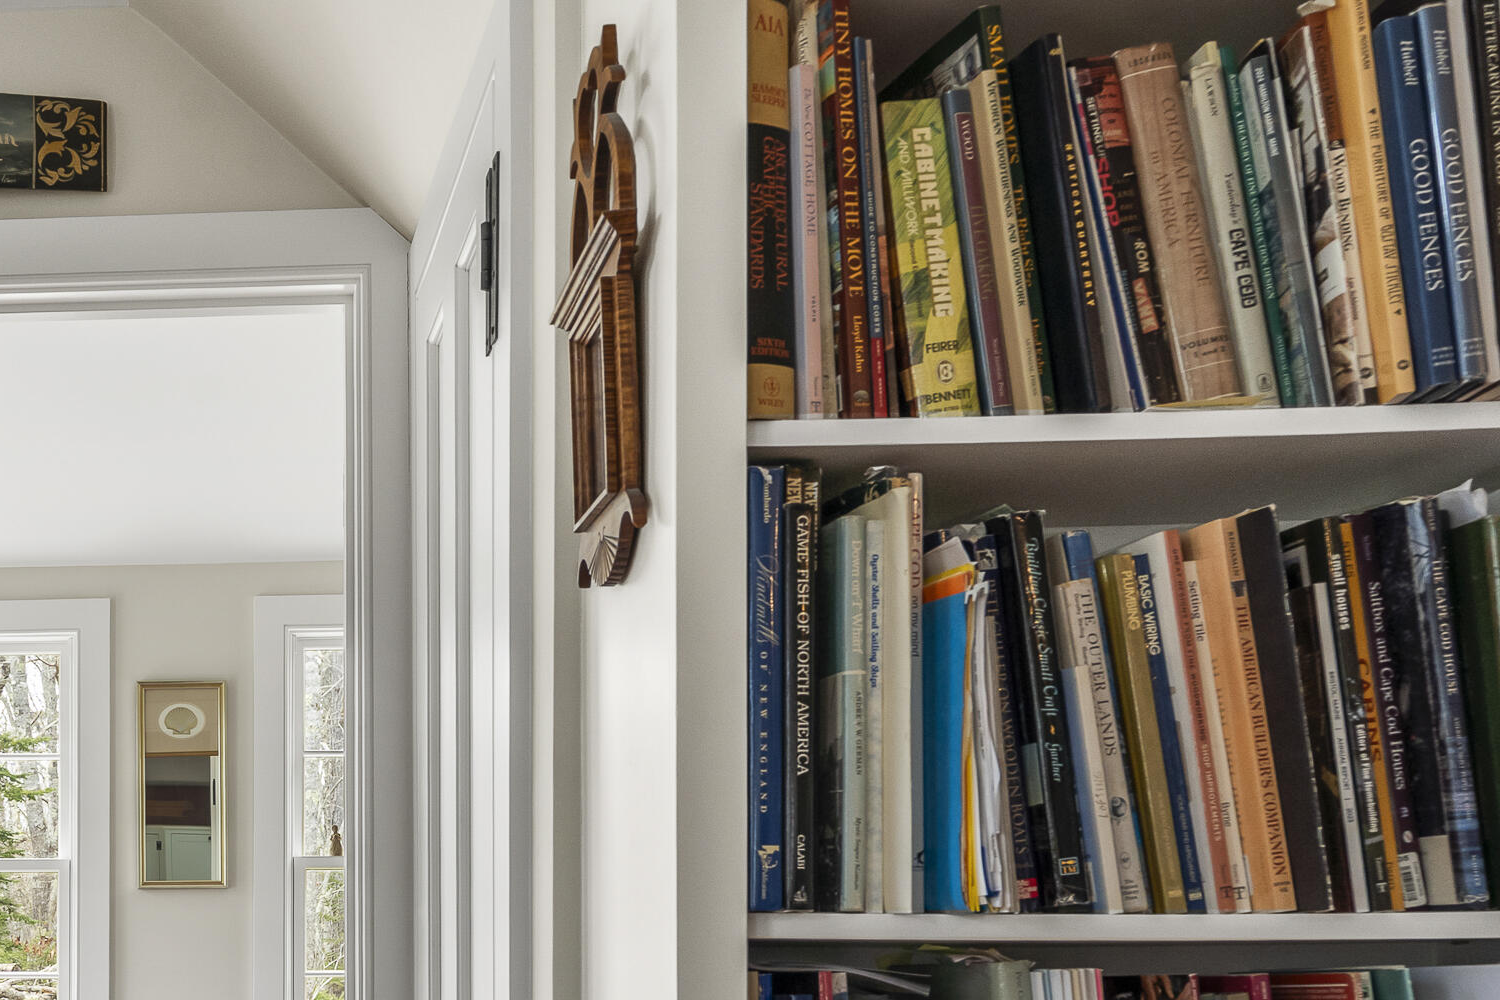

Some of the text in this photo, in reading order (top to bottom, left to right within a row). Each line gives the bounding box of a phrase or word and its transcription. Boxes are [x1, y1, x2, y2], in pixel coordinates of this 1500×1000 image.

[1399, 40, 1419, 87] Hubbell
[1432, 29, 1451, 76] Hubbell
[1203, 76, 1219, 117] LAWSON
[762, 136, 777, 218] GRAPHIC
[835, 6, 863, 297] TINY HOMES ON THE MOVE
[898, 137, 910, 164] AND
[961, 118, 975, 160] WOOD
[774, 139, 789, 291] ARCHITECTURAL
[900, 167, 919, 237] MILLWORK
[911, 127, 956, 318] CABINETMAKING
[987, 80, 1027, 307] VICTORIAN WOODTURNINGS AND WOODWORK
[1064, 144, 1096, 307] NAUTICAL QUARTERLY
[1161, 97, 1210, 288] COLONIAL FURNITURE
[1408, 138, 1444, 292] GOOD FENCES
[1440, 127, 1475, 283] GOOD FENCES
[750, 182, 764, 289] STANDARDS
[851, 315, 865, 373] Lloyd Kahn
[925, 339, 960, 355] FEIRER
[869, 554, 880, 688] Oyster Shells and Sailing Ships
[1080, 591, 1096, 627] THE
[1121, 570, 1142, 631] PLUMBING
[1137, 574, 1161, 656] BASIC WIRING
[1187, 580, 1206, 642] Setting Tile
[1330, 553, 1352, 631] small houses
[1432, 560, 1458, 696] THE CAPE COD HOUSE
[796, 514, 810, 776] GAME FISH OF NORTH AMERICA
[1087, 633, 1107, 693] OUTER
[1368, 581, 1407, 790] Saltbox and Cape Cod Houses
[1044, 742, 1065, 782] Gardner
[1095, 699, 1119, 757] LANDS
[1235, 605, 1287, 876] THE AMERICAN BUILDER'S COMPANION
[796, 834, 806, 870] CALABI
